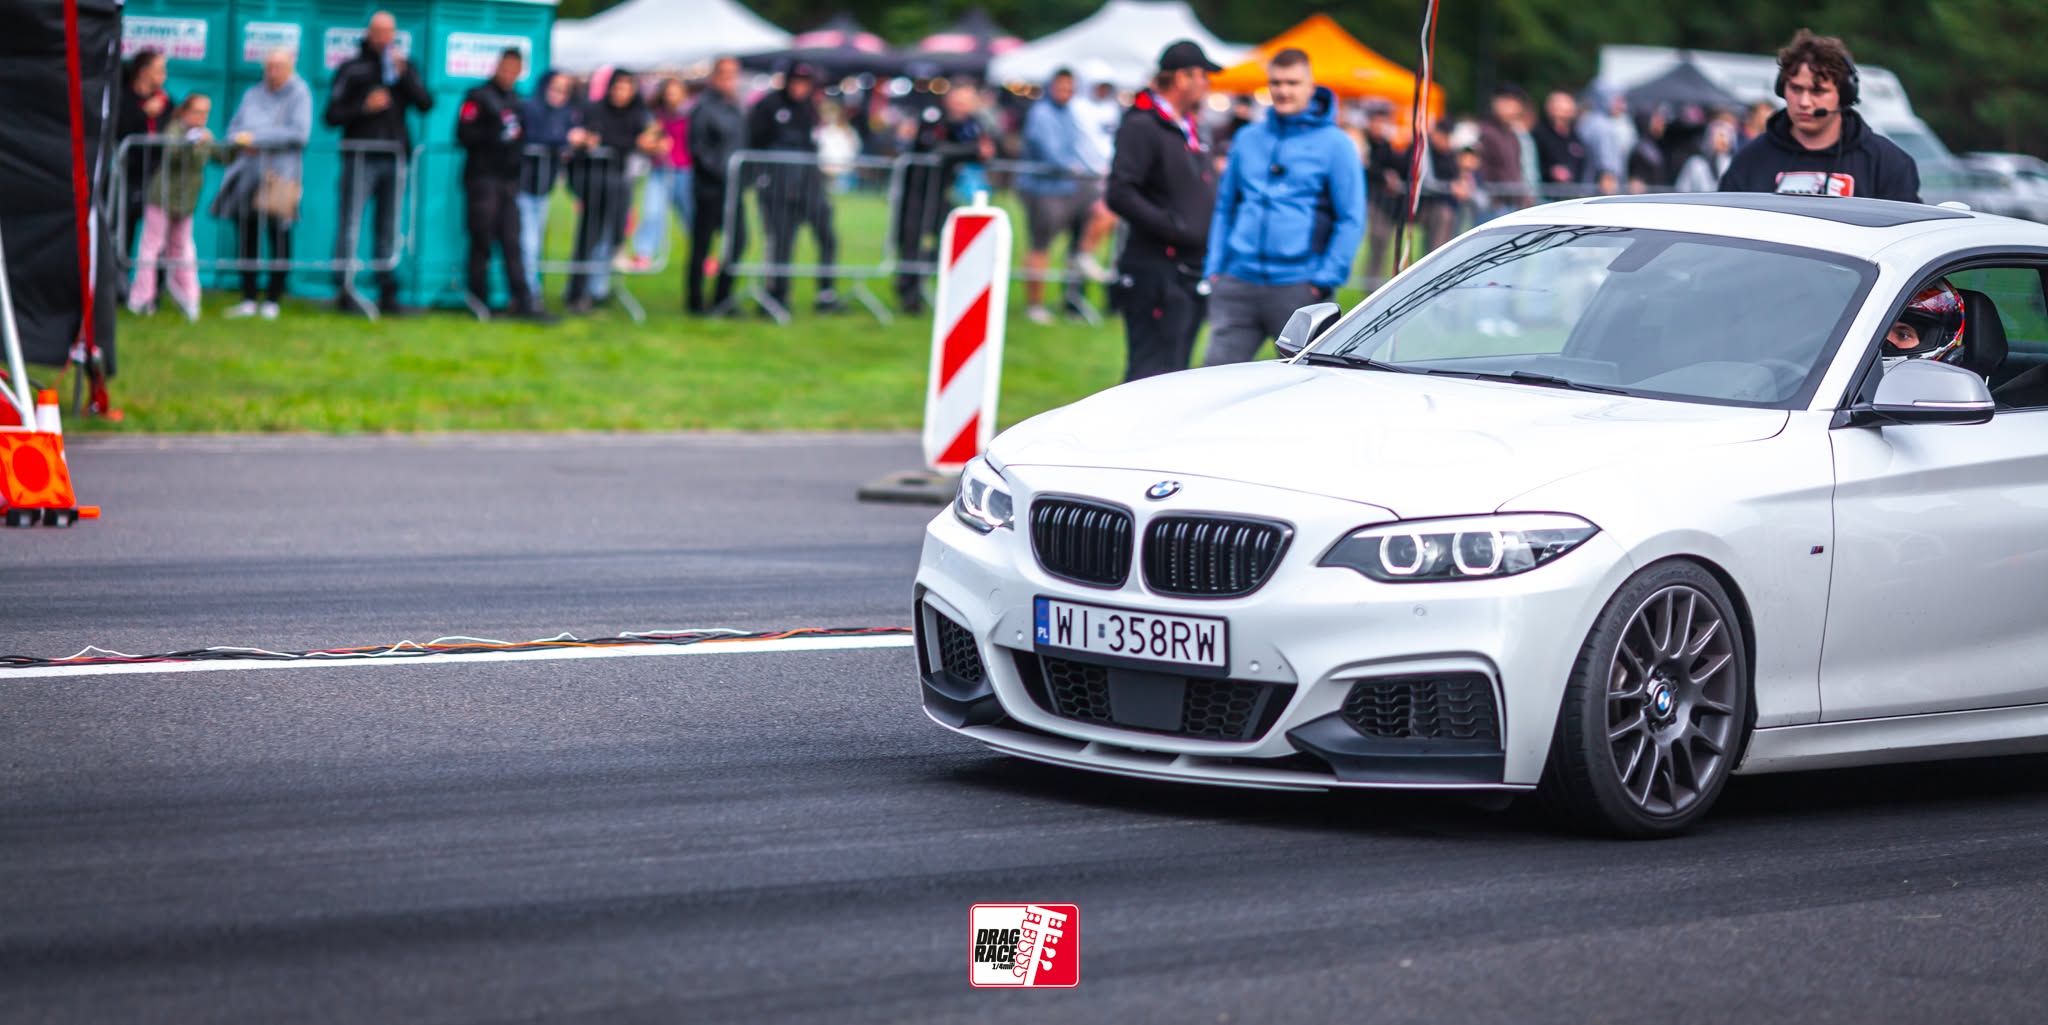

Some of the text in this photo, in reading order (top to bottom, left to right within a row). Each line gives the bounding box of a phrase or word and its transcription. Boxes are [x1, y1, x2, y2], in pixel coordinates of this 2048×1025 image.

[1037, 626, 1049, 639] PL
[1056, 606, 1216, 663] WI 358RW
